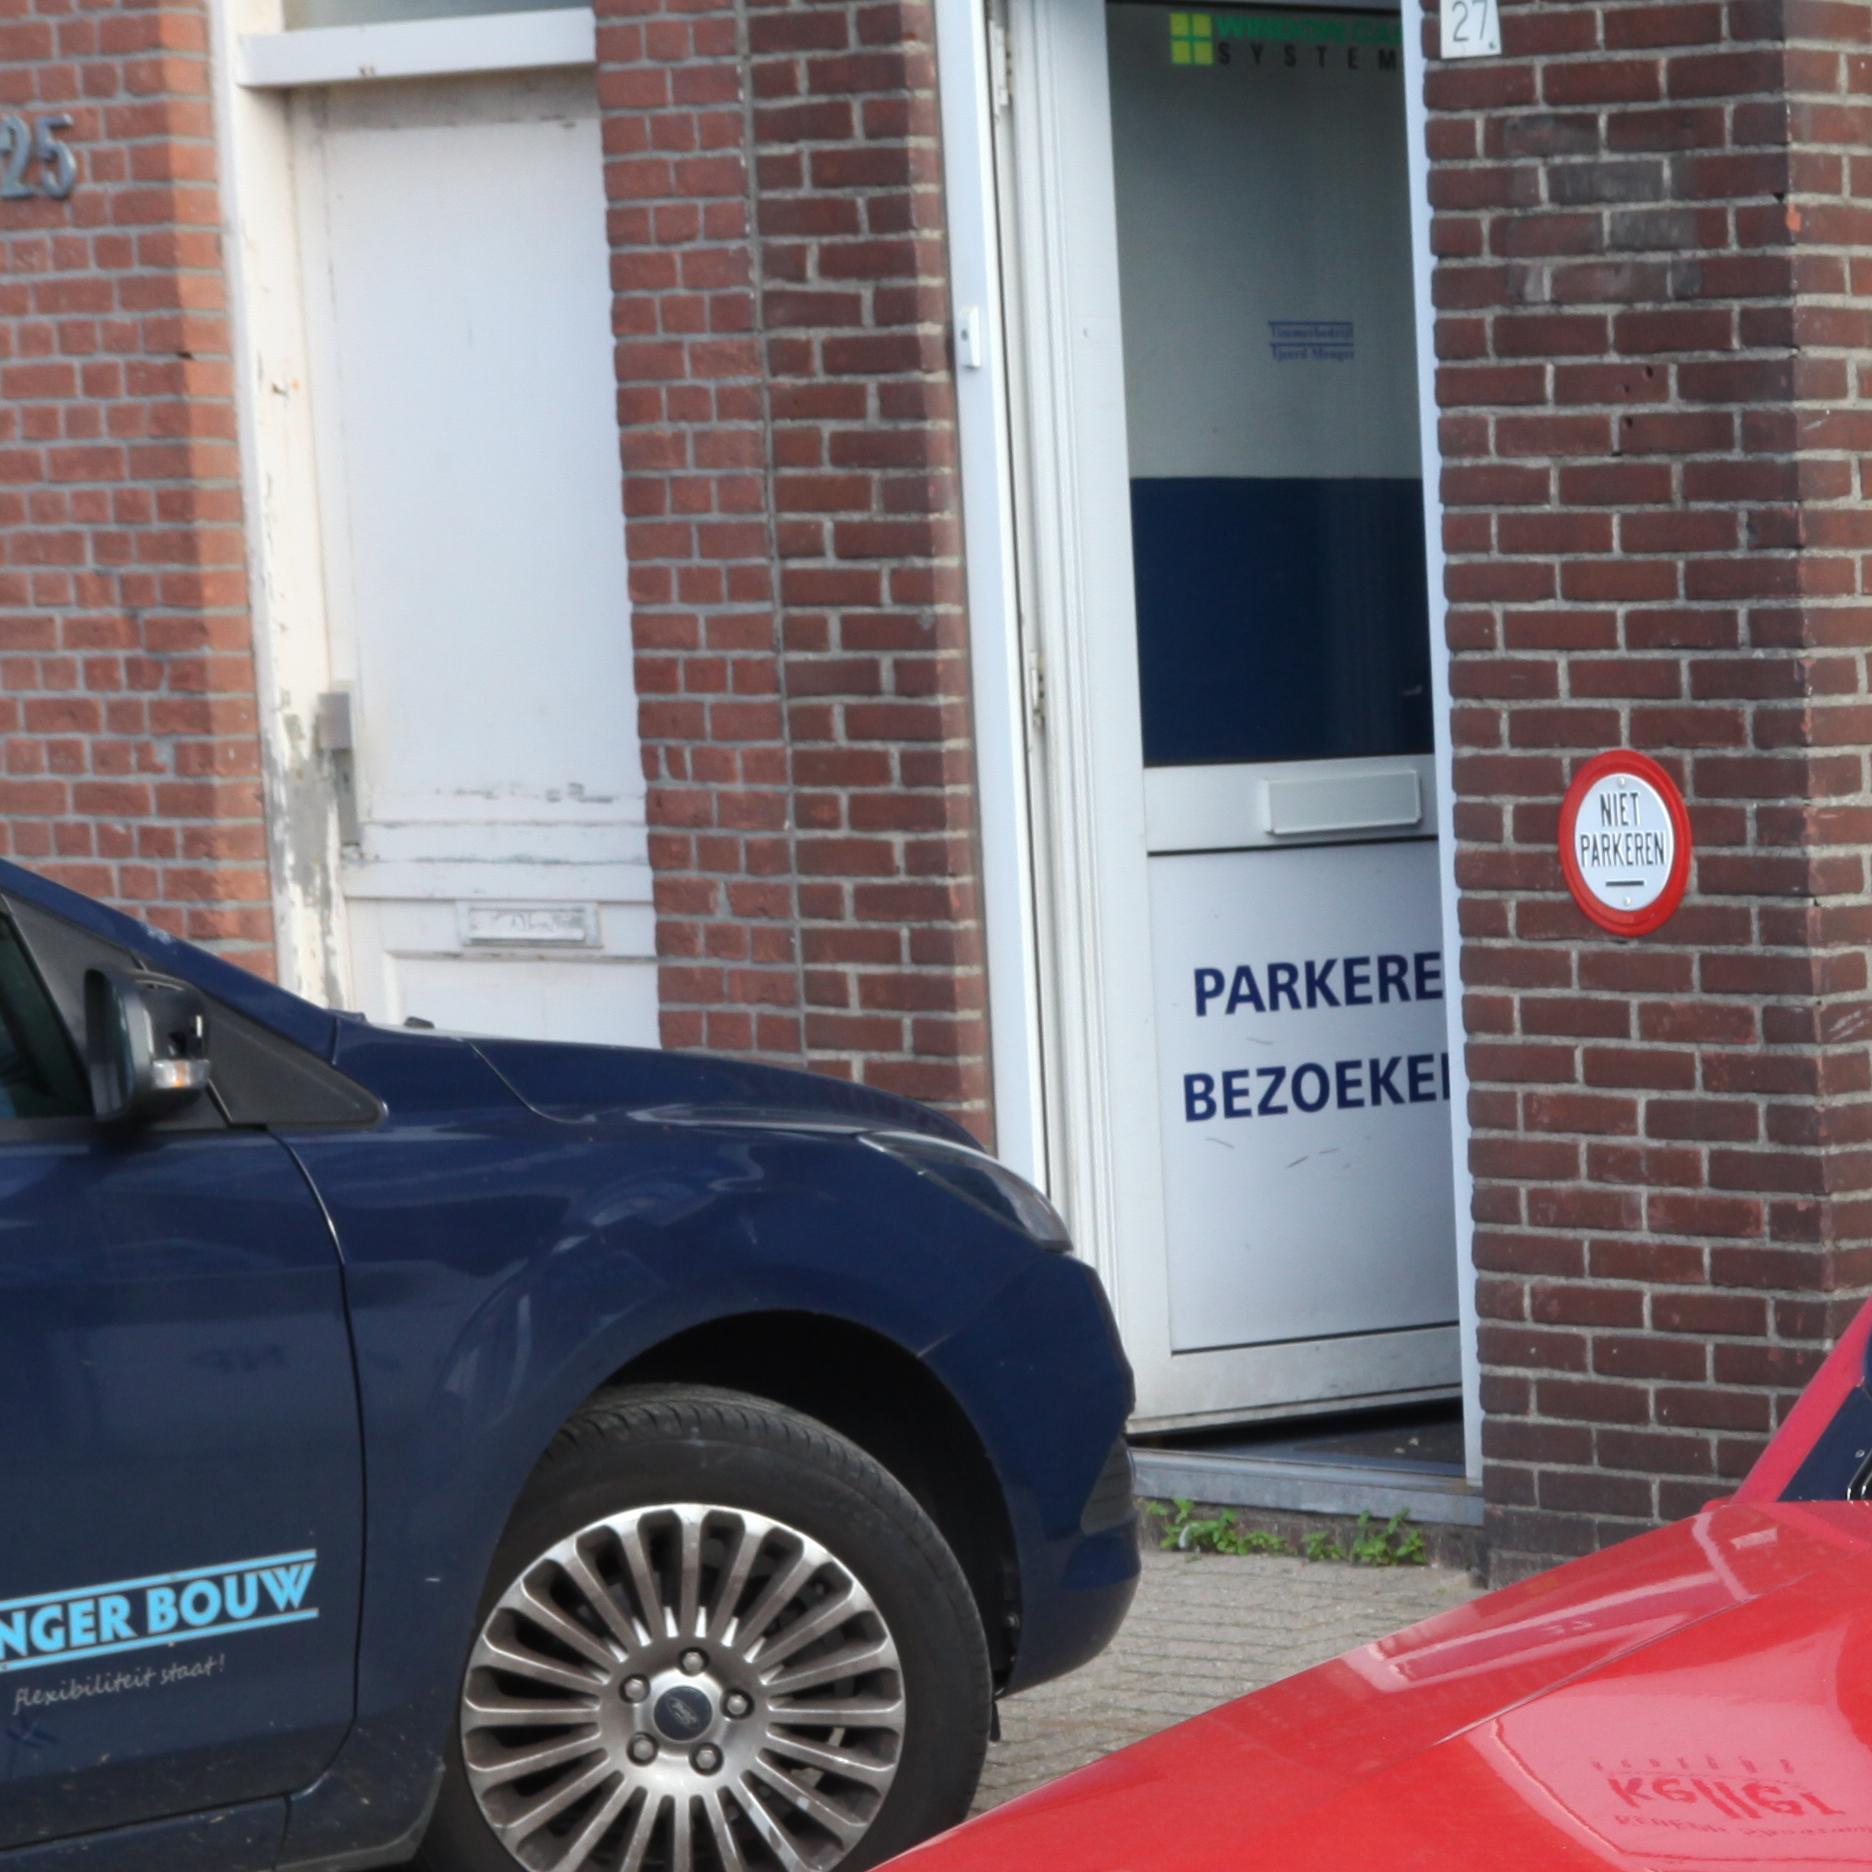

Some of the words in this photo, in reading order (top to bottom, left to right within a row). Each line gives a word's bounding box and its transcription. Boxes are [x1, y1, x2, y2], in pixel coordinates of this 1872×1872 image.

[1452, 0, 1488, 42] 27
[1599, 792, 1639, 827] NIET
[1580, 831, 1665, 868] PARKEREN
[1194, 951, 1444, 1017] PARKERE
[147, 1561, 317, 1635] BOUW
[12, 1667, 156, 1716] flexibiliteit
[160, 1653, 226, 1686] staat!
